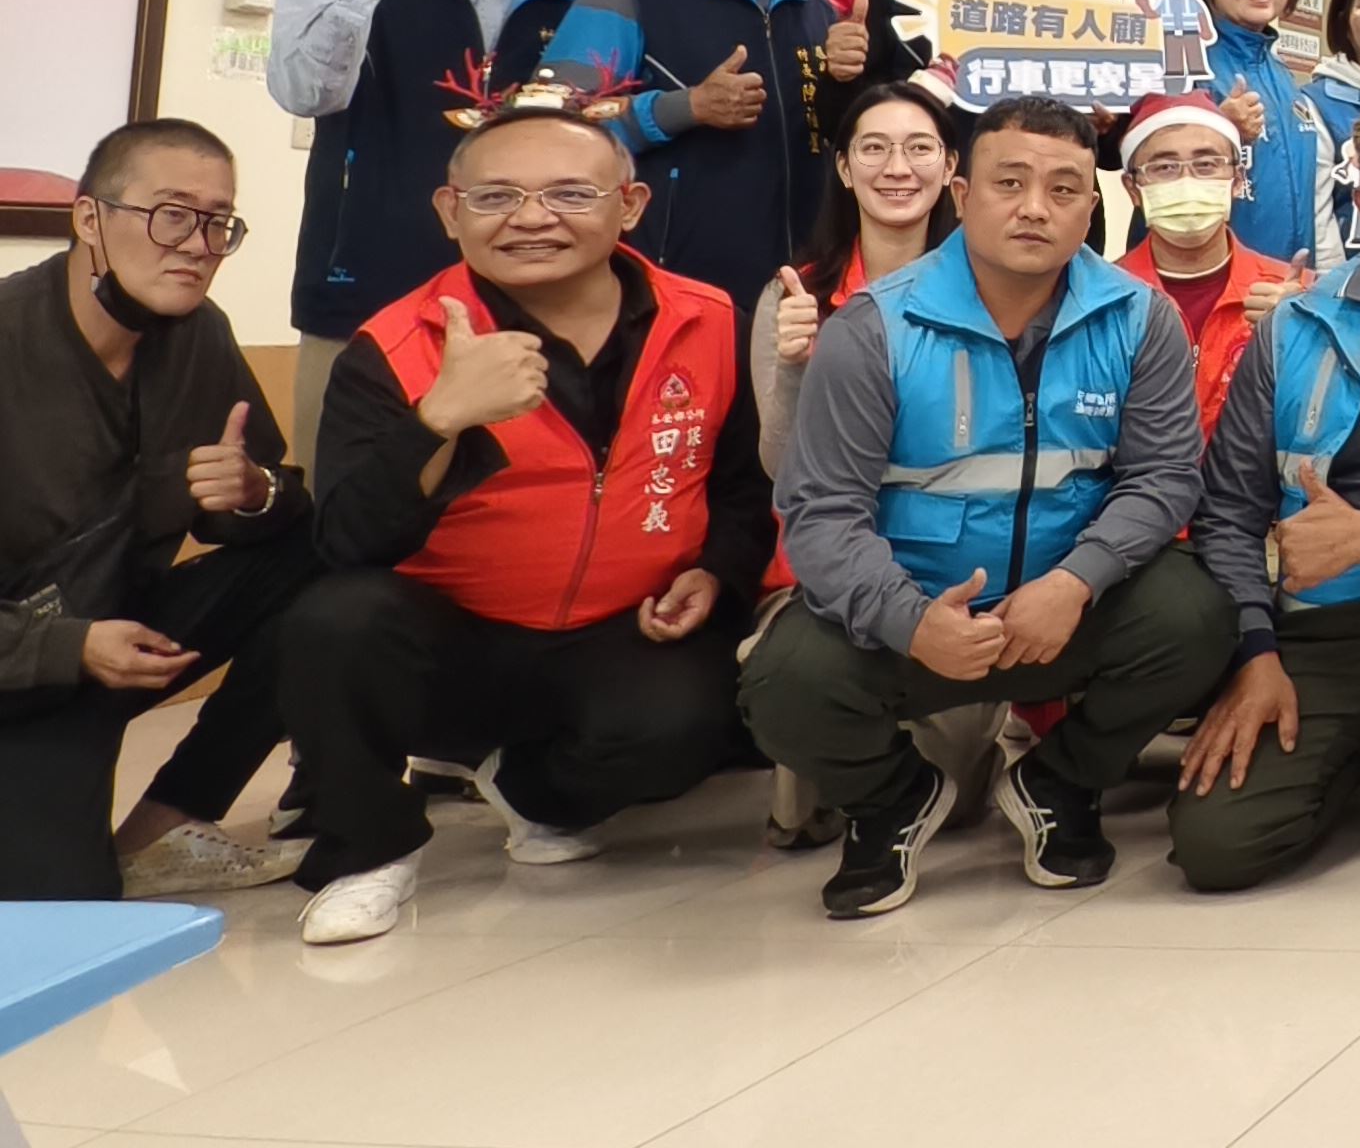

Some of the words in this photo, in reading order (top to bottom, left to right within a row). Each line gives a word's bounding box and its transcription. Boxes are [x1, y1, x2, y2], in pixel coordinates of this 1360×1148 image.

[966, 57, 1167, 98] 行車更安全
[641, 428, 681, 533] 田忠義
